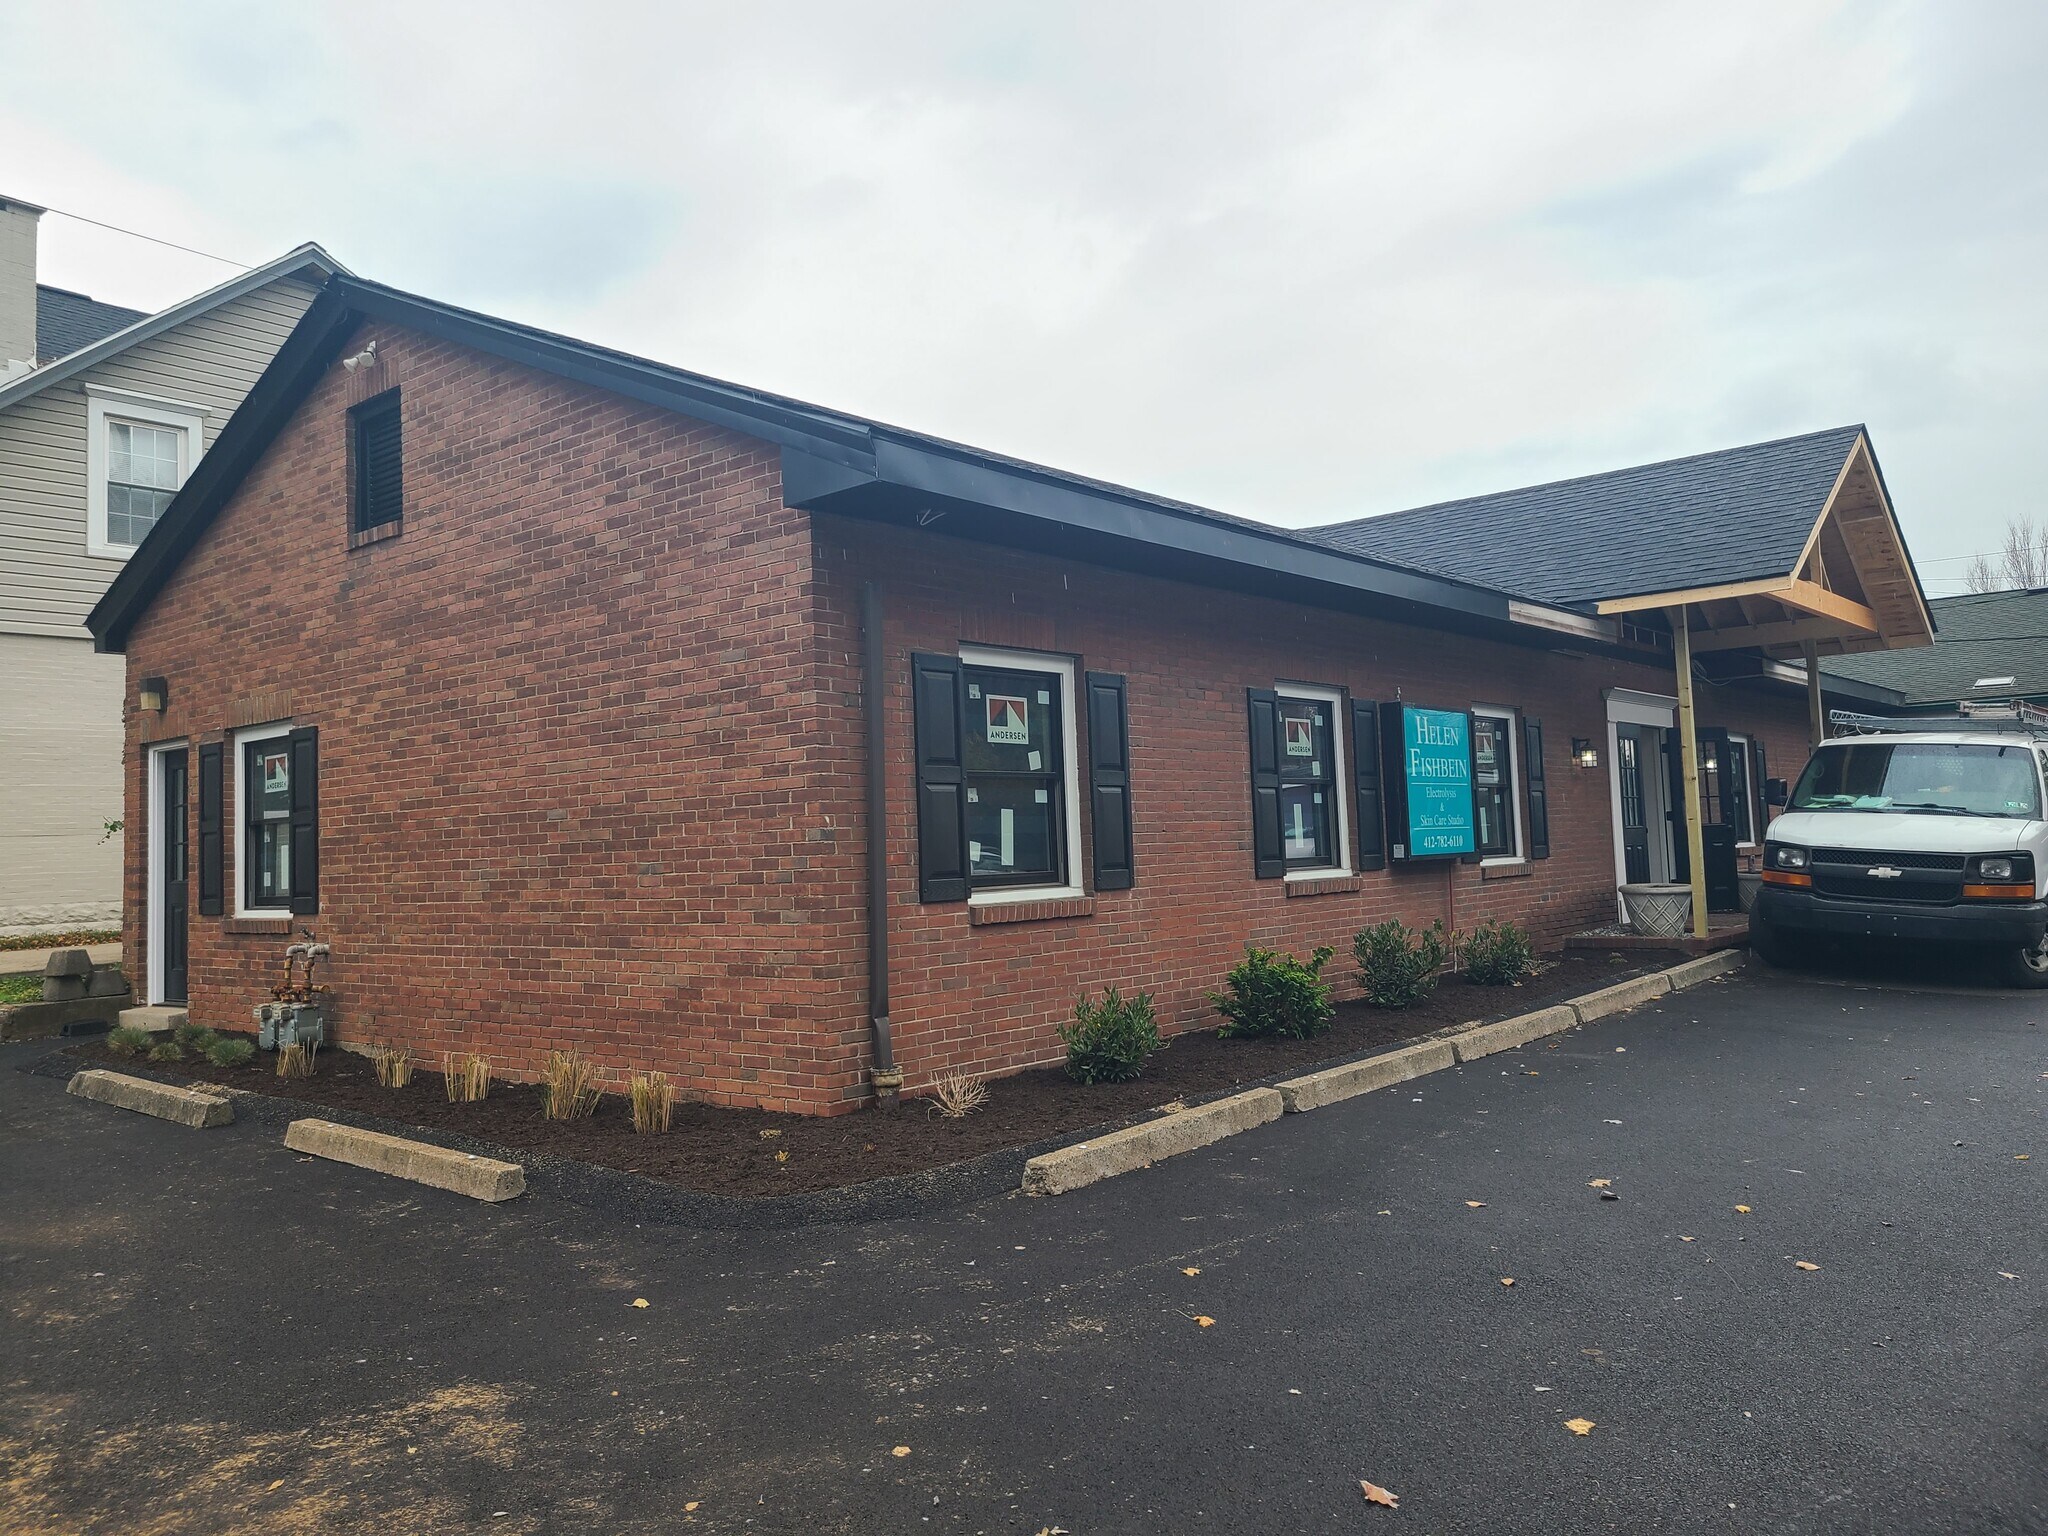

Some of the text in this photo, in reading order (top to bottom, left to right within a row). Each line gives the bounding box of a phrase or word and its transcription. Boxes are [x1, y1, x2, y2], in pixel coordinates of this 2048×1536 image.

[990, 731, 1026, 740] ANDERSEN
[1416, 715, 1459, 746] HELEN
[1289, 745, 1311, 753] ANDERSEN
[1410, 748, 1467, 777] FISHBEIN
[1426, 787, 1457, 800] Electrolysis
[1440, 803, 1445, 812] &
[1420, 815, 1464, 825] Skin Care Studio
[1423, 835, 1463, 848] 412-782-6110
